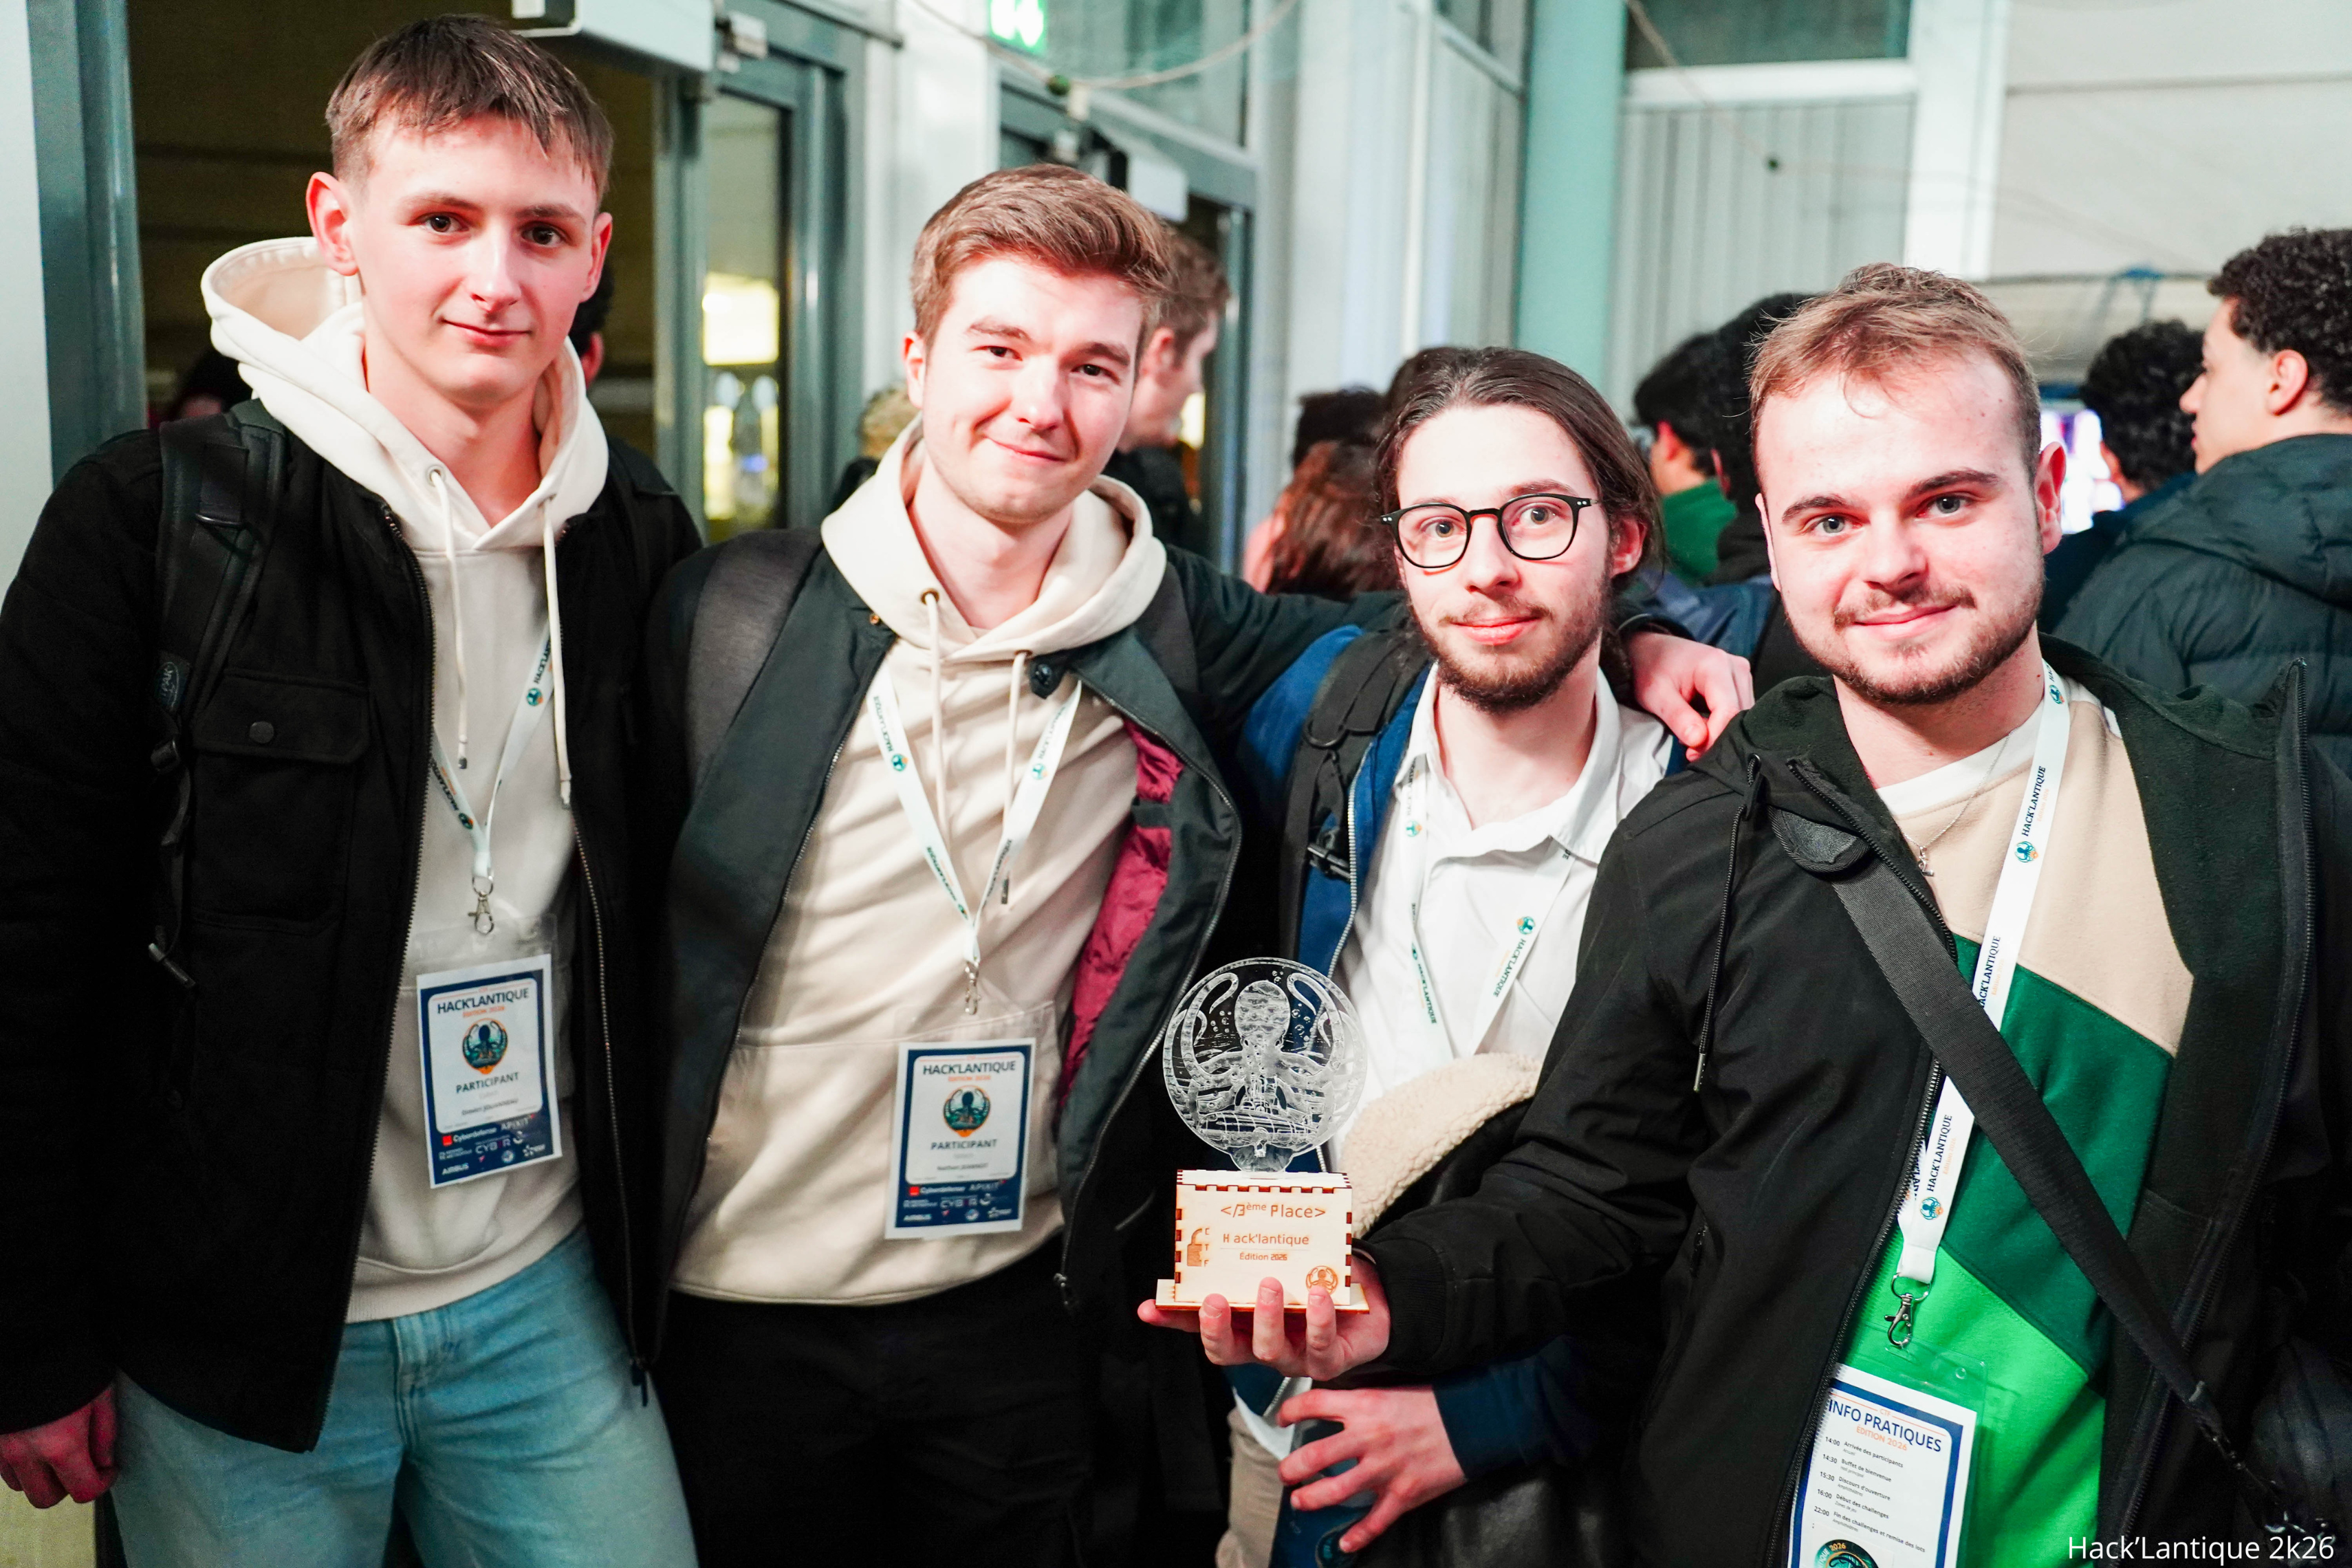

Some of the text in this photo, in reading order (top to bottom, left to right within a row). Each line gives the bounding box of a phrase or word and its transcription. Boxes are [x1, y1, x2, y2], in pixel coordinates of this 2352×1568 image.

[2021, 765, 2046, 837] HACK'LANTIQUE
[1977, 935, 2001, 1008] ACK'LANTIQUE
[437, 988, 529, 1014] HACK'LANTIQUE
[923, 1060, 1016, 1075] HACK'LANTIQUE
[455, 1074, 519, 1094] PARTICIPANT
[930, 1139, 998, 1151] PARTICIPANT
[1926, 1114, 1952, 1193] HACK'LANTIQUE
[1239, 1252, 1269, 1261] Édition
[1829, 1399, 1942, 1452] INFO PRATIQUES
[1880, 1408, 1891, 1417] CTF
[1825, 1436, 1840, 1446] 14:00
[1844, 1441, 1862, 1452] Arrivée
[1872, 1452, 1904, 1468] participants
[1886, 1437, 1908, 1451] 2026
[1822, 1454, 1838, 1464] 14:30
[1841, 1459, 1857, 1469] Buffet
[1865, 1468, 1891, 1482] bienvenue
[1820, 1471, 1891, 1501] 15:30 Discours d'ouverture
[1817, 1489, 1832, 1499] 16:00
[1836, 1494, 1851, 1504] Début
[1862, 1504, 1889, 1519] challenges
[1814, 1505, 1829, 1516] 22:00
[1842, 1514, 1851, 1523] des
[1851, 1518, 1878, 1534] challenges
[1886, 1533, 1904, 1544] remise
[1829, 1543, 1847, 1551] 2026
